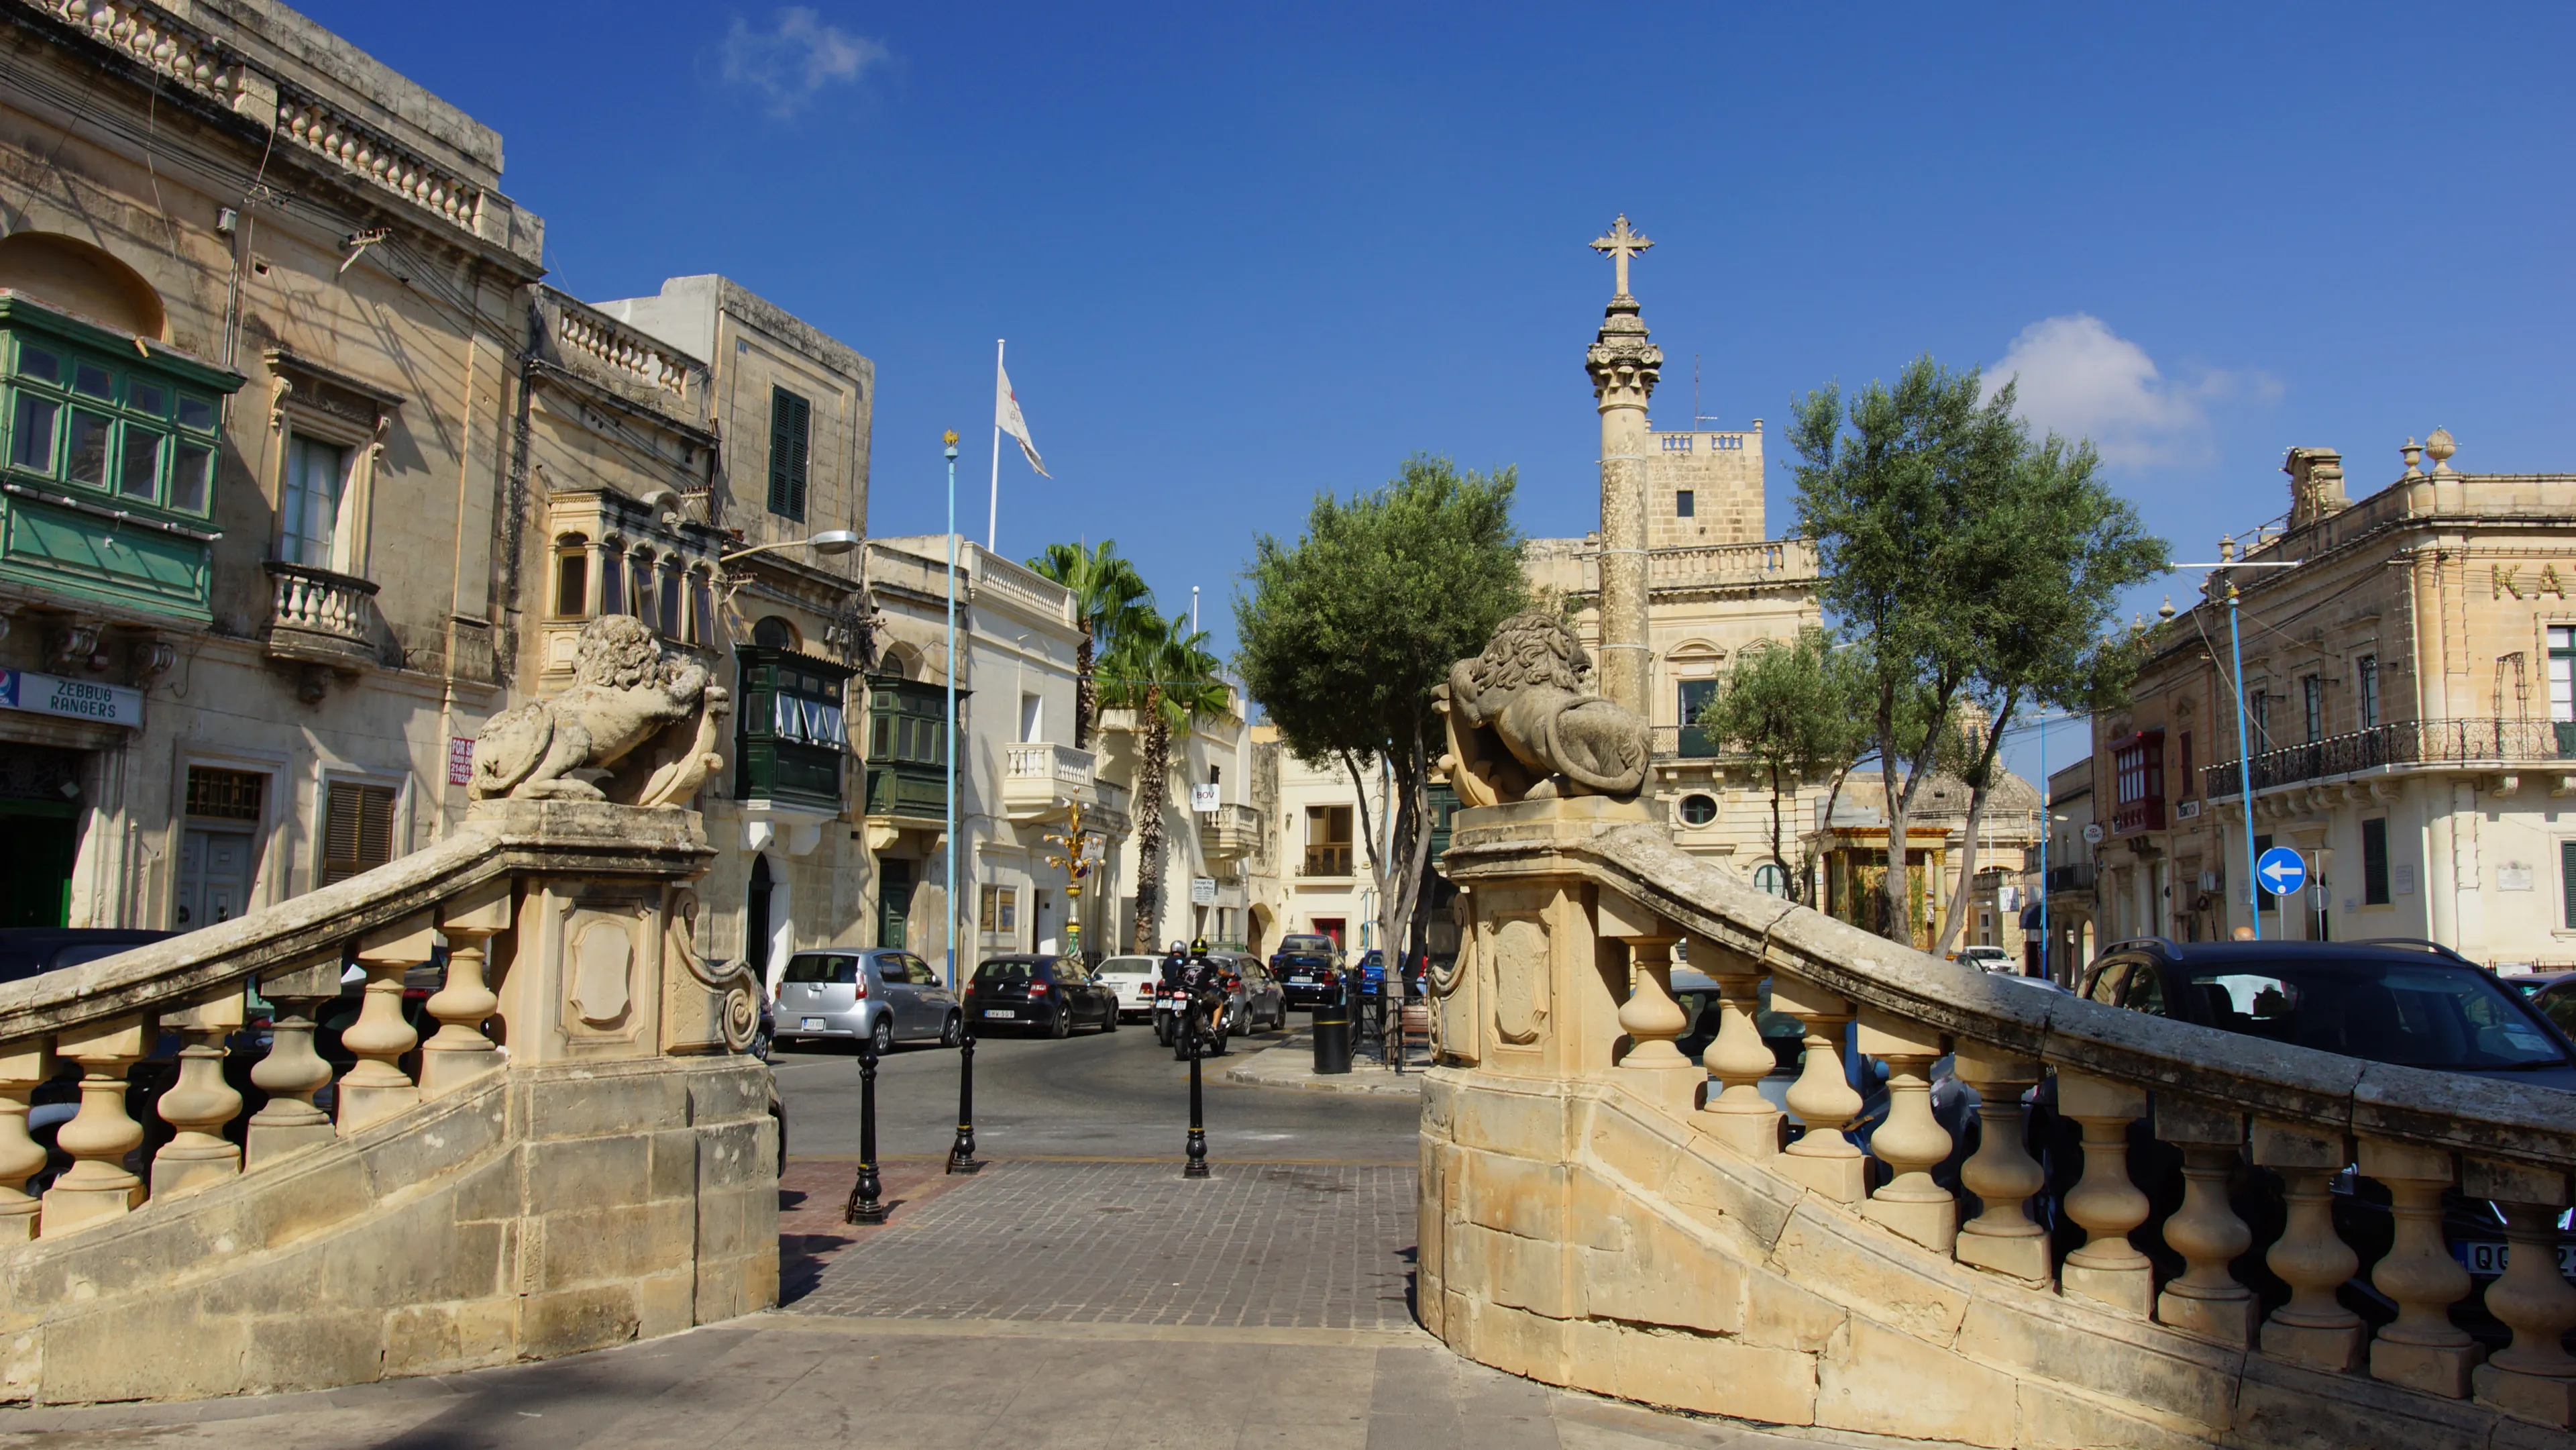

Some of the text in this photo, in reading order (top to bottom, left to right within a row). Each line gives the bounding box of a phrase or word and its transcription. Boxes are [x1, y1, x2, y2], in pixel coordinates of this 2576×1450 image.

[2491, 562, 2576, 601] KA
[50, 695, 116, 718] RANGERS
[452, 739, 474, 757] FOR SA
[451, 764, 472, 775] 214611
[2475, 1245, 2509, 1270] QQ
